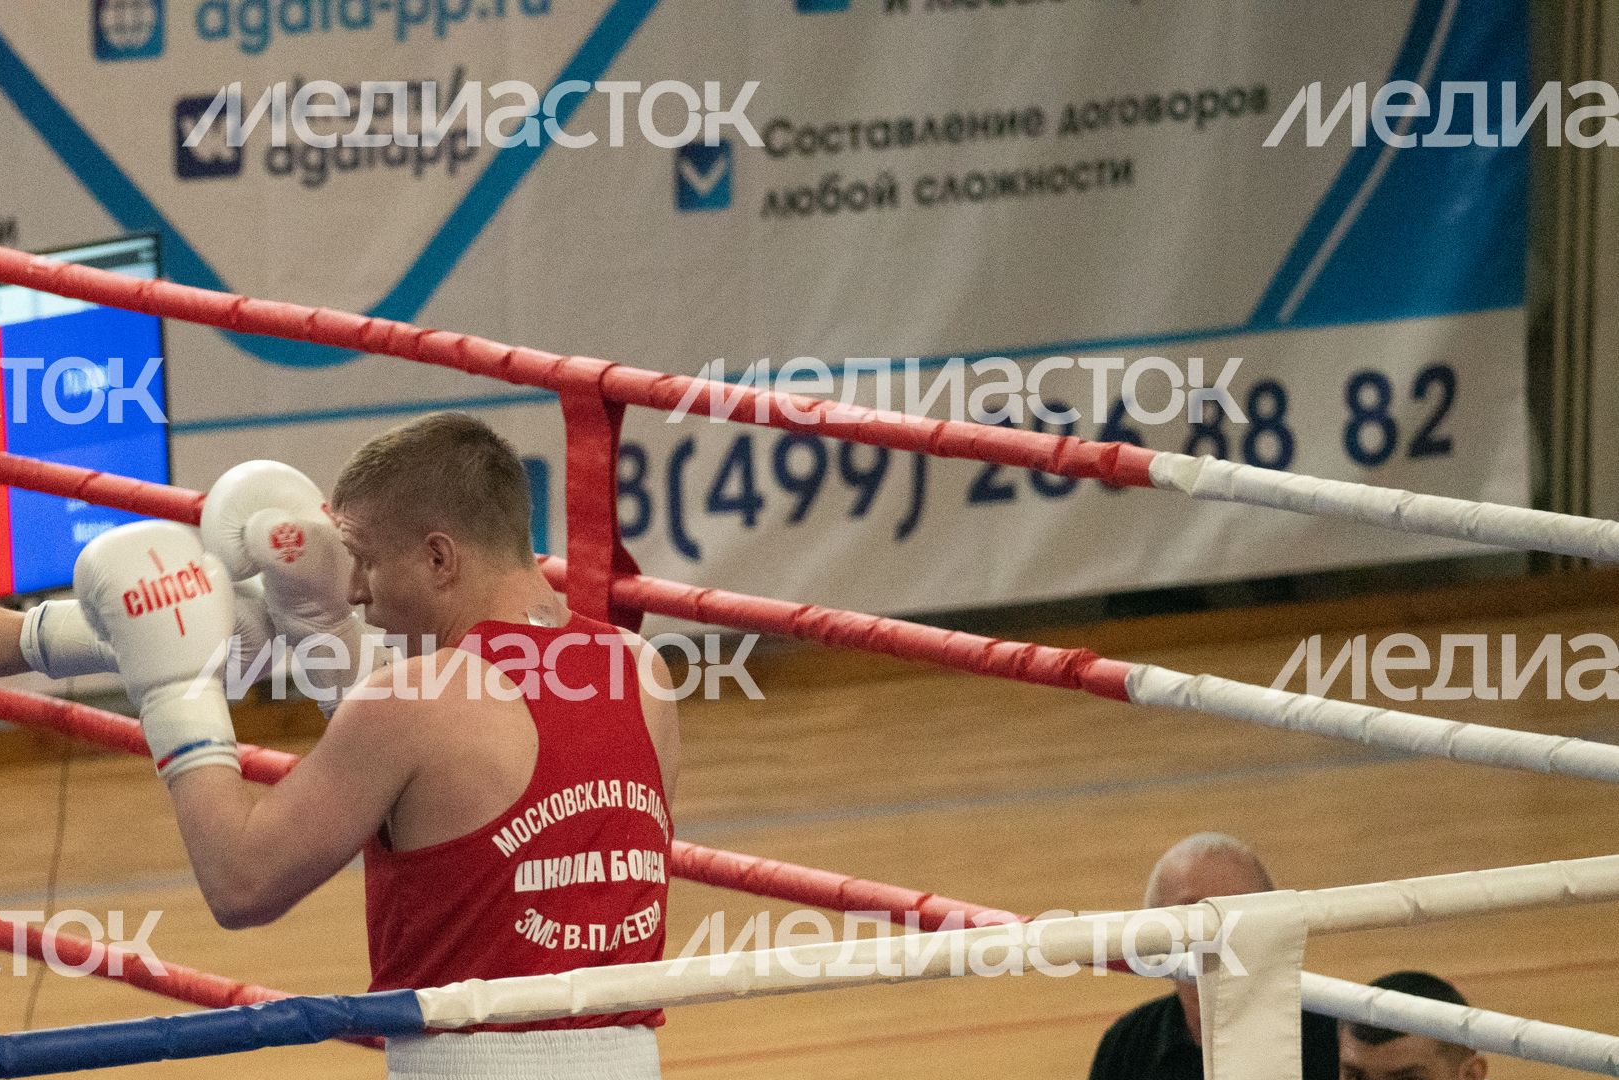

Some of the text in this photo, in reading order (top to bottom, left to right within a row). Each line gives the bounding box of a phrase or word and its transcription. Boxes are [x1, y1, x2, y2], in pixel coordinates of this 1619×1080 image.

[762, 83, 1268, 159] Составление договоров
[761, 158, 1133, 220] любой сложности
[1342, 363, 1458, 468] 82
[122, 559, 213, 619] clinch
[491, 778, 623, 858] МОСКОВСКАЯ
[514, 848, 666, 893] ШКОЛА БОКСА
[514, 907, 561, 950] ЗМС
